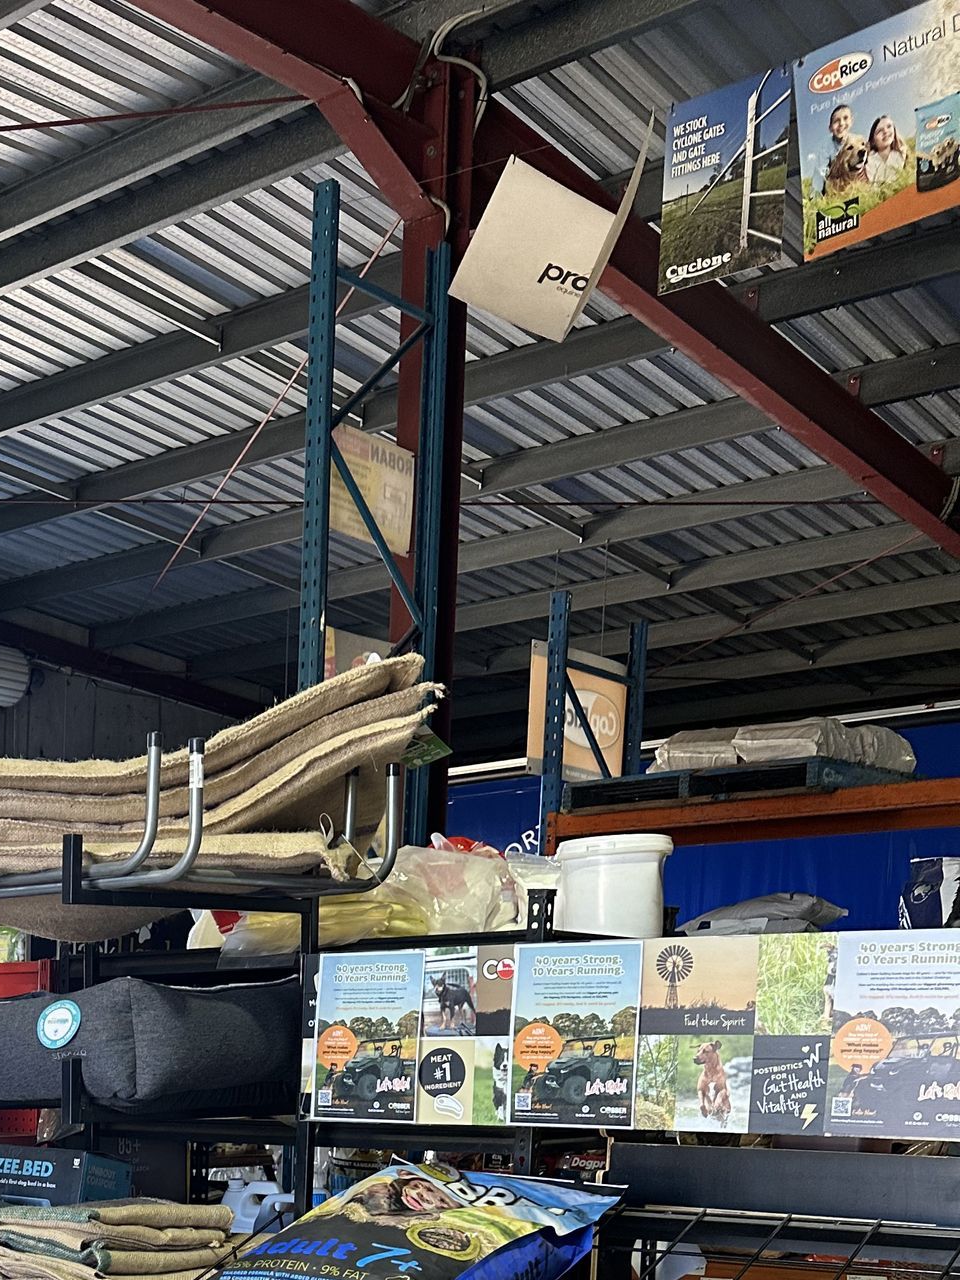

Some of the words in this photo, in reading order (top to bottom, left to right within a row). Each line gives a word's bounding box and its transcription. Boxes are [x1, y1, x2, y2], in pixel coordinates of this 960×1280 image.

[882, 19, 946, 62] Natural
[813, 57, 869, 88] CopRice
[673, 124, 685, 138] WE
[686, 115, 707, 133] STOCK
[672, 133, 702, 151] CYCLONE
[703, 123, 725, 141] GATES
[672, 150, 687, 165] AND
[688, 143, 706, 161] GATE
[671, 160, 701, 178] FITTINGS
[702, 152, 721, 169] HERE
[818, 216, 831, 231] all
[818, 214, 858, 240] natural
[666, 251, 732, 284] Cyclone
[860, 943, 877, 953] 40
[880, 943, 915, 954] years
[536, 956, 549, 965] 40
[552, 956, 580, 966] years
[856, 955, 871, 965] 10
[873, 955, 908, 964] Years
[336, 964, 348, 973] 40
[350, 964, 373, 974] years
[533, 967, 544, 976] 10
[546, 967, 574, 976] Years
[334, 974, 343, 983] 10
[345, 974, 368, 982] Years
[684, 1014, 699, 1028] Fuel
[700, 1014, 720, 1026] their
[720, 1014, 746, 1030] Spirit
[430, 1054, 452, 1063] MEAT
[433, 1063, 451, 1082] #1
[754, 1062, 803, 1075] POSTBIOTICS
[424, 1081, 462, 1091] INGREDIENT
[763, 1078, 788, 1096] Gut
[787, 1069, 826, 1091] Health
[791, 1091, 807, 1099] AND
[756, 1094, 800, 1117] Vitality
[17, 1179, 27, 1187] dog
[355, 1241, 423, 1272] 7+
[253, 1258, 310, 1272] PROTEIN
[320, 1264, 340, 1277] 9%
[342, 1269, 370, 1280] FAT
